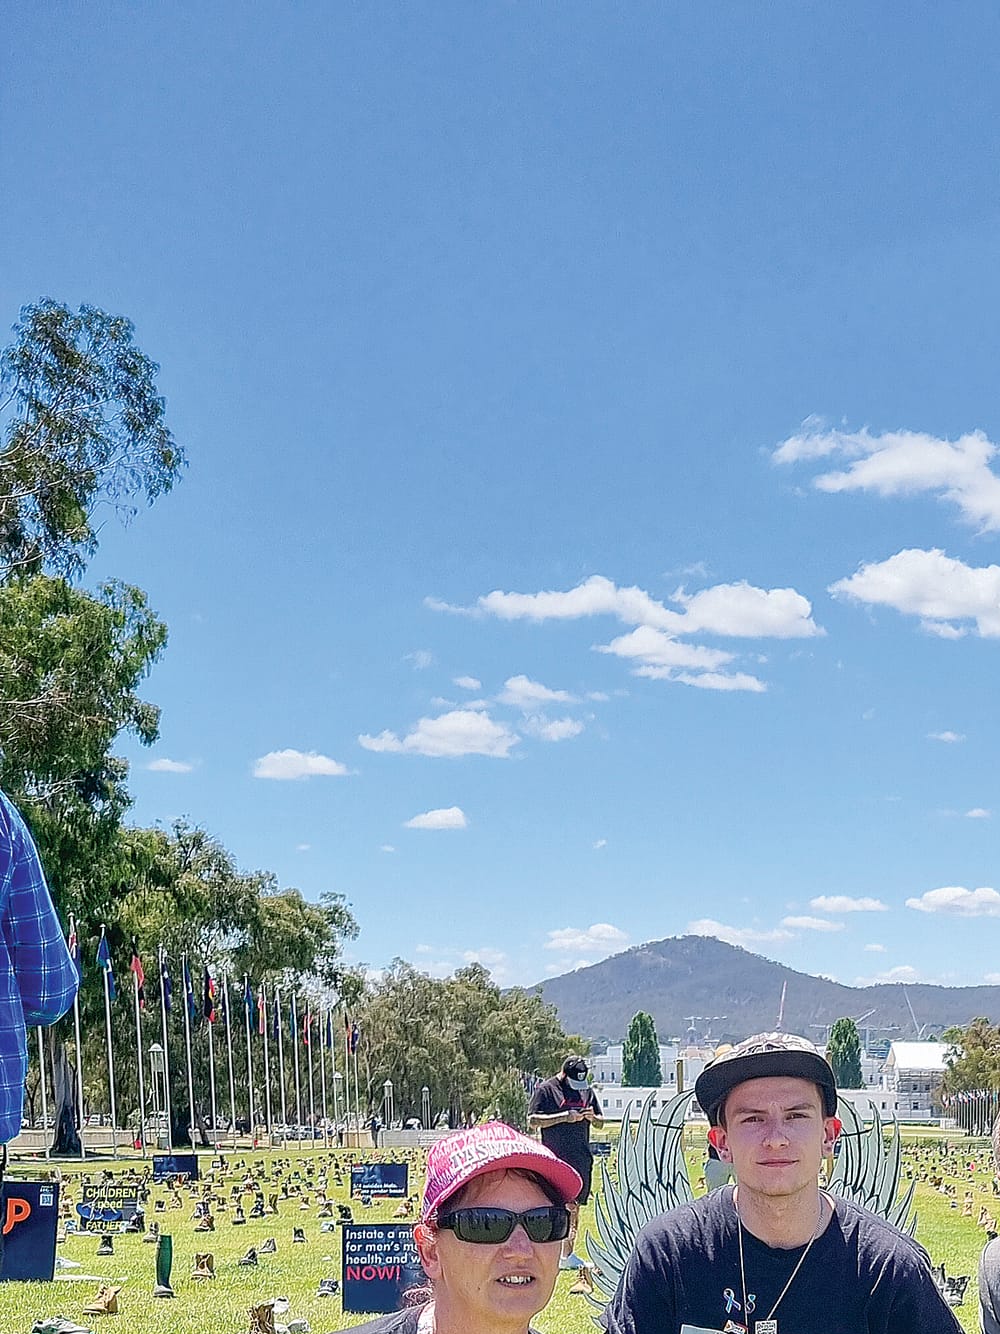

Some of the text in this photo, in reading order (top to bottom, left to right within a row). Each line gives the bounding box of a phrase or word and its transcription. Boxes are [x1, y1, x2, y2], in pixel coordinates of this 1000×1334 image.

[86, 1187, 137, 1198] CHILDREN
[97, 1199, 123, 1209] need
[345, 1229, 384, 1239] Instate
[387, 1231, 395, 1239] a
[345, 1241, 363, 1252] for
[365, 1241, 400, 1252] men's
[345, 1253, 382, 1265] health
[385, 1253, 408, 1265] and
[346, 1265, 401, 1281] NOW!
